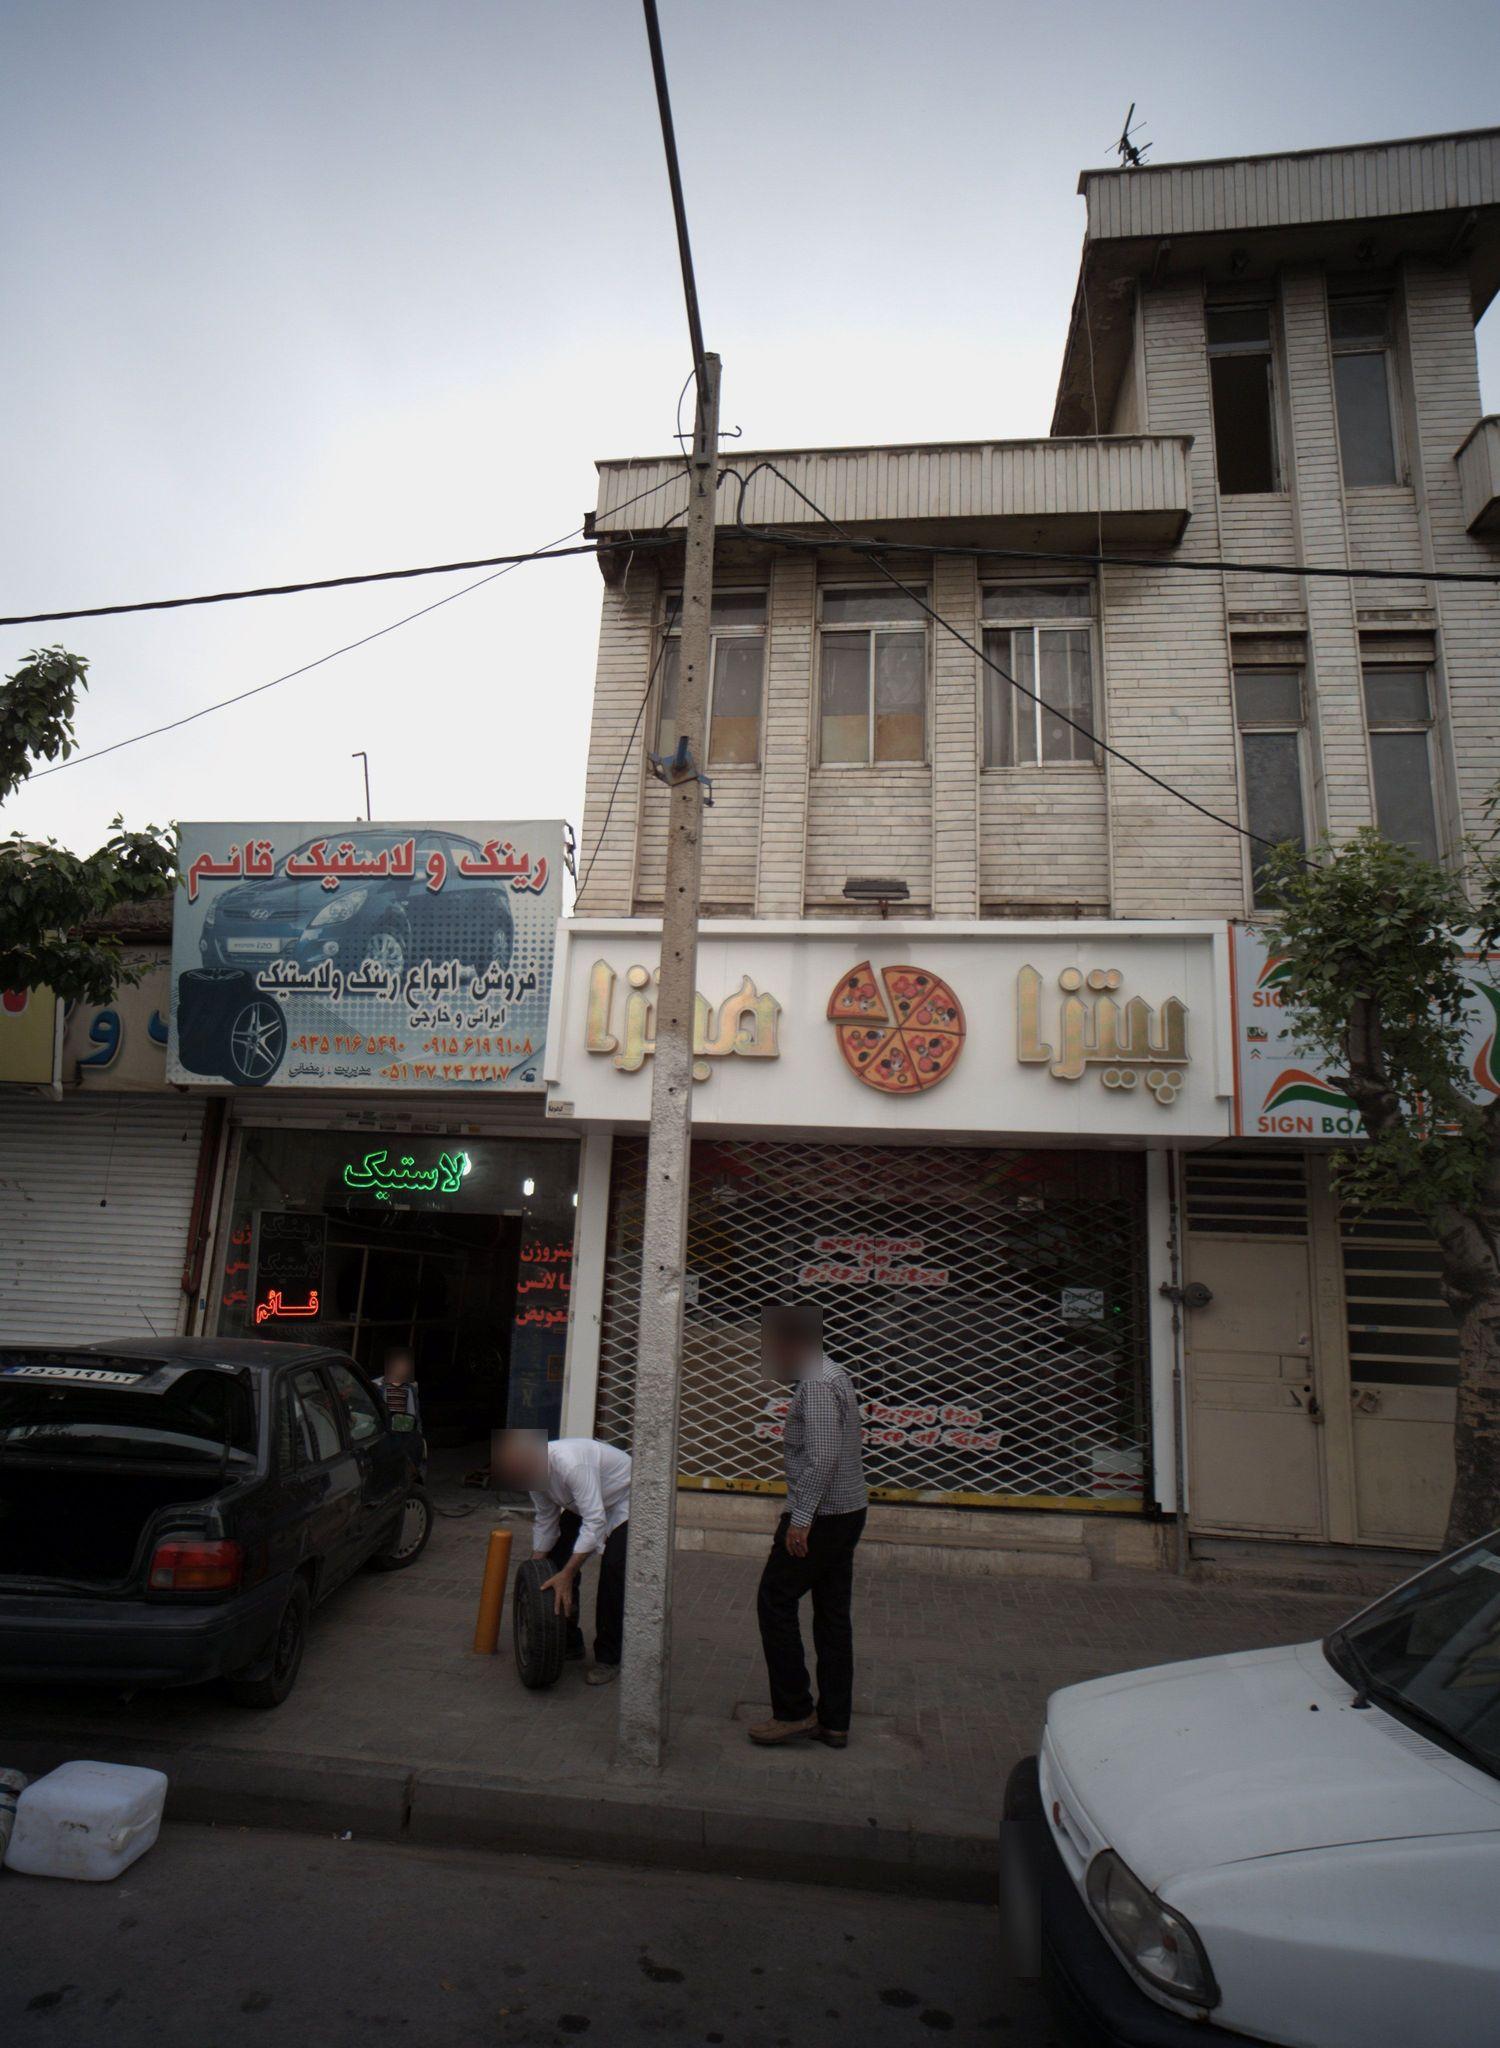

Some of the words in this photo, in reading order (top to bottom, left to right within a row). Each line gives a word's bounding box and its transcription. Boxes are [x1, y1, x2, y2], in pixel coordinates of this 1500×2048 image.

[188, 840, 274, 900] قائم
[287, 839, 415, 888] لاستیک
[427, 852, 446, 891] و
[459, 839, 548, 890] رینگ
[349, 961, 398, 1001] رینگ
[406, 961, 457, 1009] انواع
[472, 961, 536, 1001] فروش
[410, 1005, 450, 1028] خارجی
[455, 1012, 463, 1028] و
[467, 1007, 505, 1029] ایرانی
[1017, 964, 1191, 1104] پیتزا
[291, 1035, 330, 1054] ۰۹۳۵
[366, 1035, 405, 1054] ۵۴۹۰
[423, 1037, 459, 1054] ۰۹۱۵
[496, 1037, 533, 1056] ۹۱۰۸
[334, 1063, 372, 1078] مدیریت
[380, 1063, 408, 1081] ۰۵۱
[1258, 1116, 1313, 1133] SIGN
[1321, 1116, 1367, 1134] BOA
[344, 1149, 466, 1199] لاستیک
[256, 1289, 319, 1325] قائم
